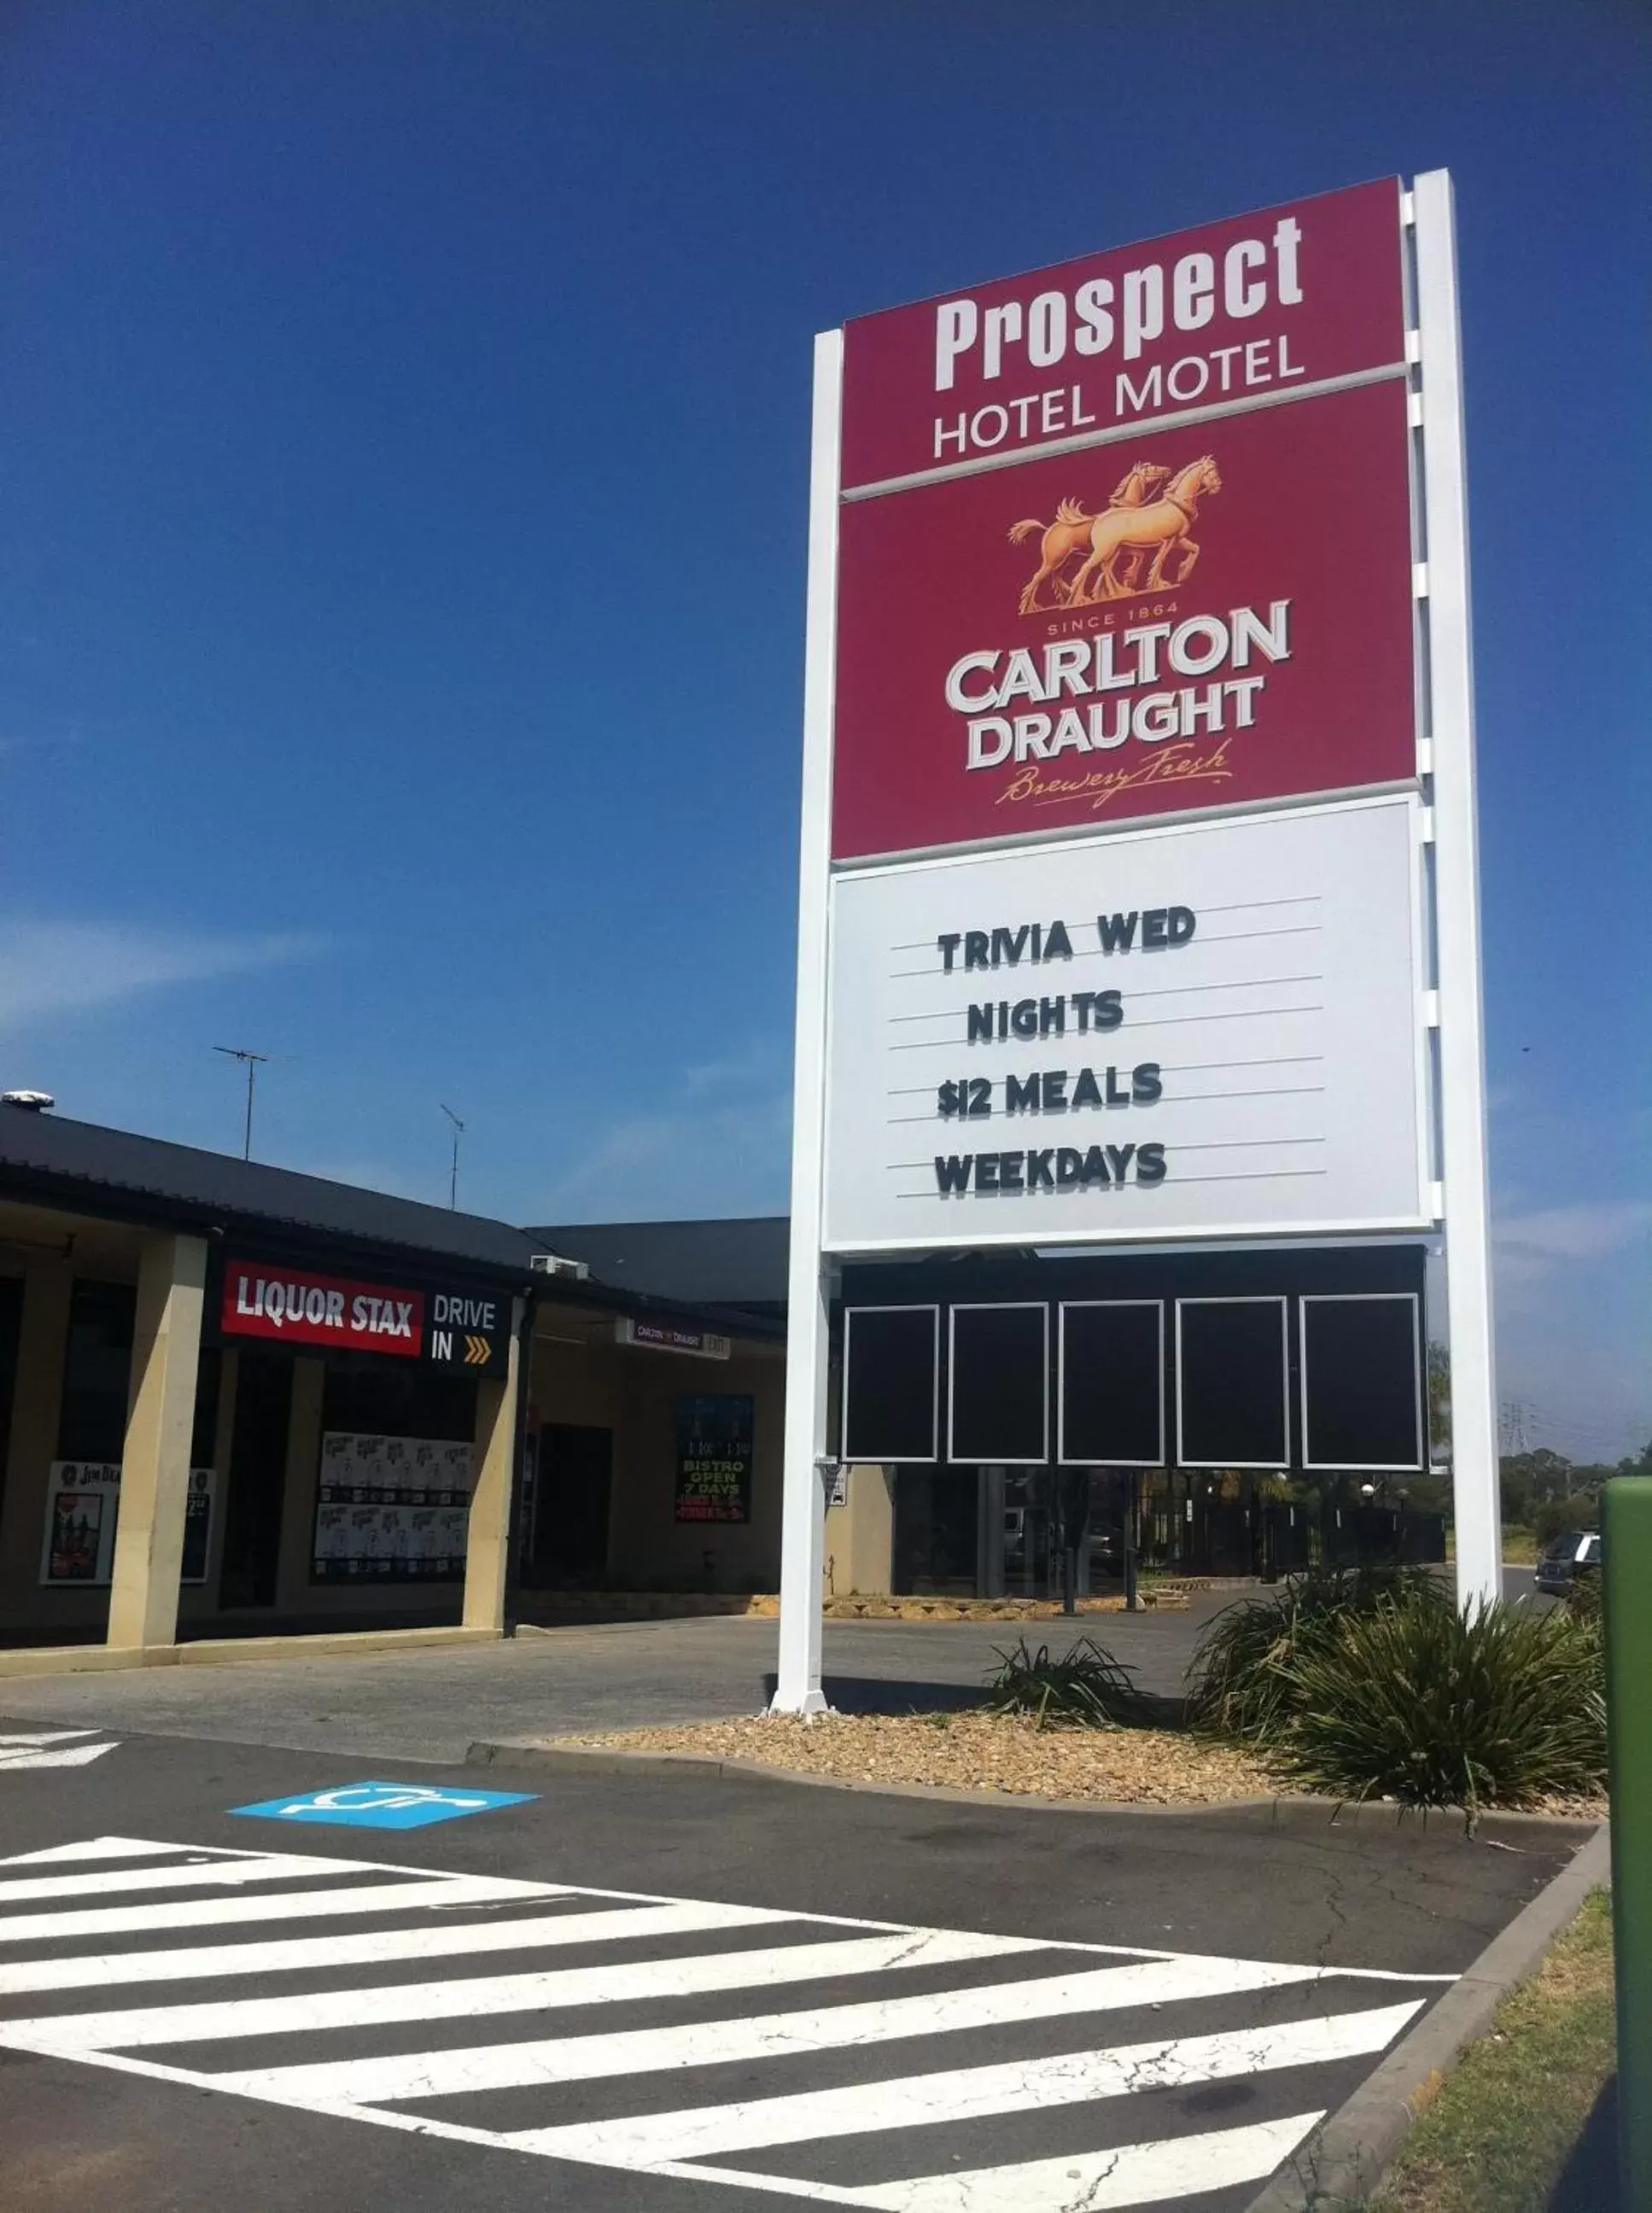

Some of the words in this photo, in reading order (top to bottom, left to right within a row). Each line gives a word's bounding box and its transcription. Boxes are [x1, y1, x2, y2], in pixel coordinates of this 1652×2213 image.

[935, 217, 1303, 392] Prospect
[933, 384, 1095, 458] HOTEL
[1115, 335, 1305, 416] MOTEL
[1047, 613, 1115, 635] SINCE
[1128, 603, 1179, 620] 1864
[944, 600, 1291, 713] CARLTON
[966, 676, 1265, 771] DRAUGHT
[995, 765, 1132, 807] Brewery
[1130, 738, 1233, 784] Fresh
[937, 920, 1072, 972] TRIVIA
[1097, 906, 1196, 951] WED
[967, 990, 1123, 1043] NIGHTS
[937, 1077, 991, 1118] $12
[1006, 1063, 1163, 1113] MEALS
[935, 1142, 1166, 1197] WEEKDAYS
[237, 1276, 345, 1328] LIQUOR
[350, 1296, 413, 1337] STAX
[435, 1294, 495, 1330] DRIVE
[433, 1329, 452, 1360] IN
[683, 1460, 744, 1473] BISTRO
[691, 1472, 737, 1484] OPEN
[698, 1483, 740, 1495] DAYS
